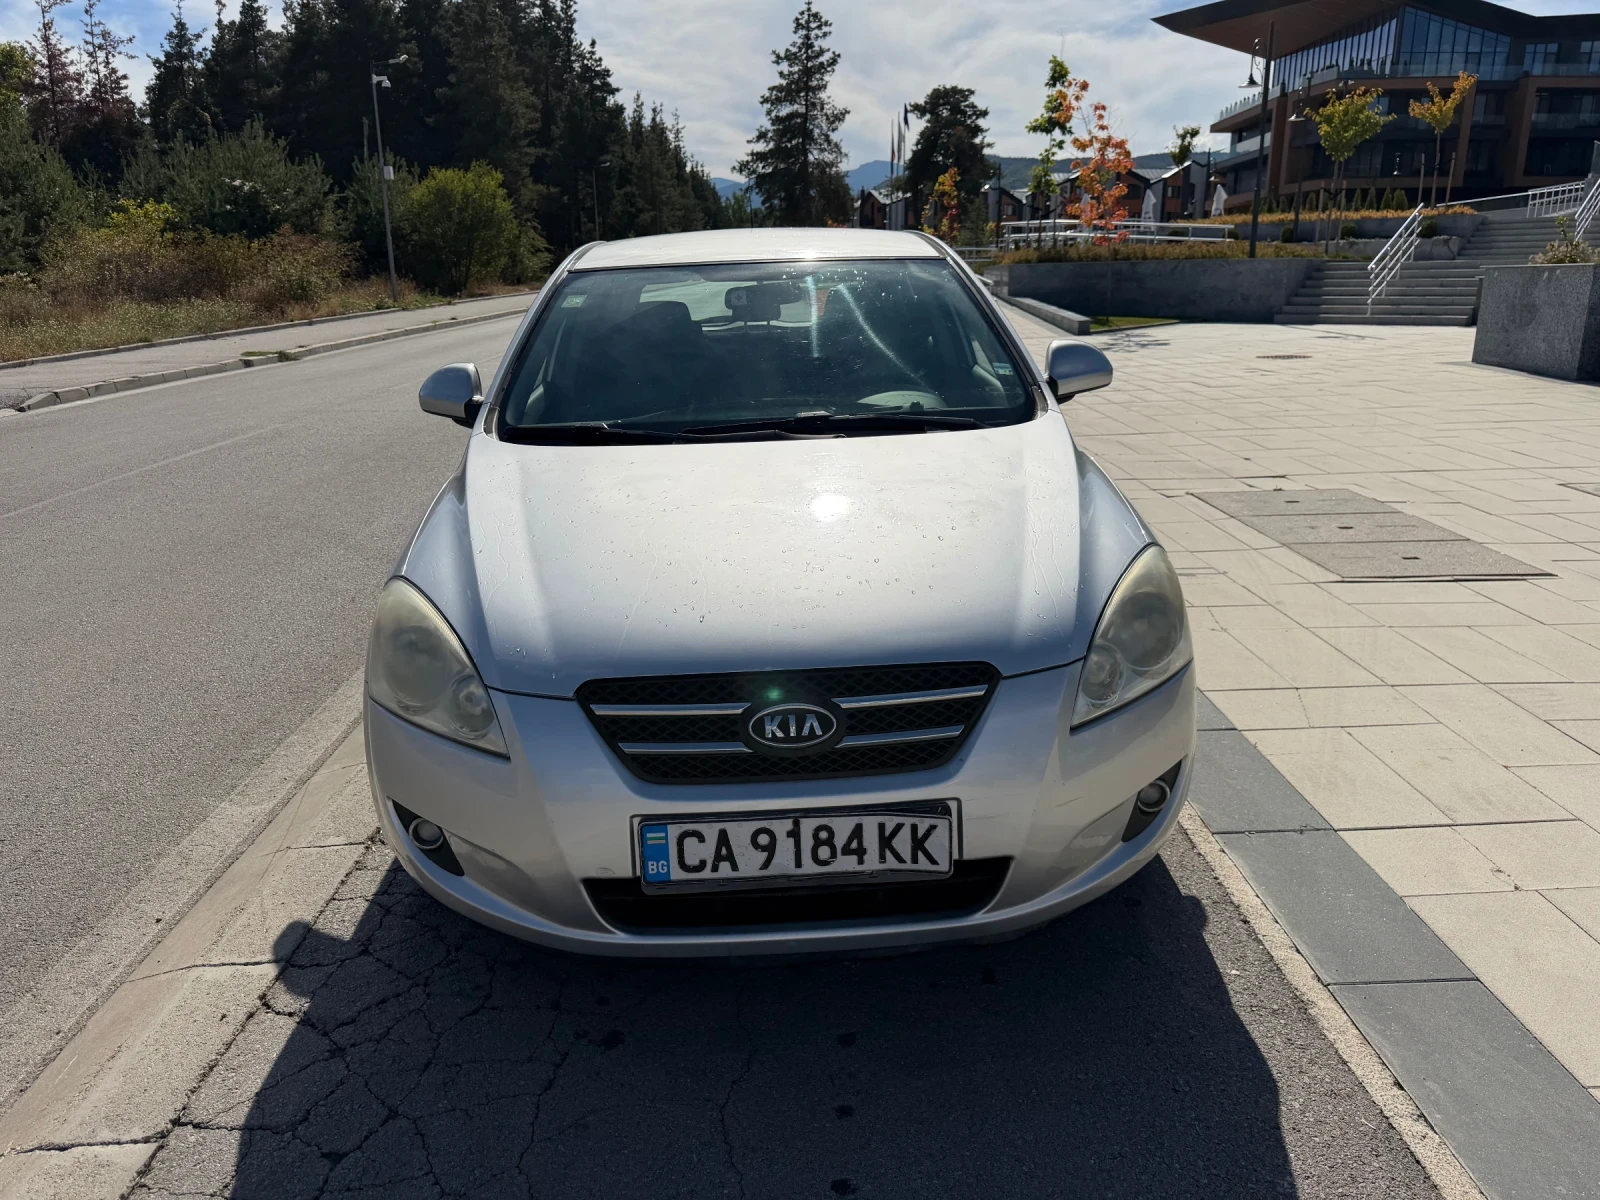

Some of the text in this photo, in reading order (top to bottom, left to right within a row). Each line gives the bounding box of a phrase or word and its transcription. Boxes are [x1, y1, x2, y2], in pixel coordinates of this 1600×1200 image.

[764, 714, 823, 738] KIA
[676, 827, 740, 873] CA
[648, 860, 668, 874] BG
